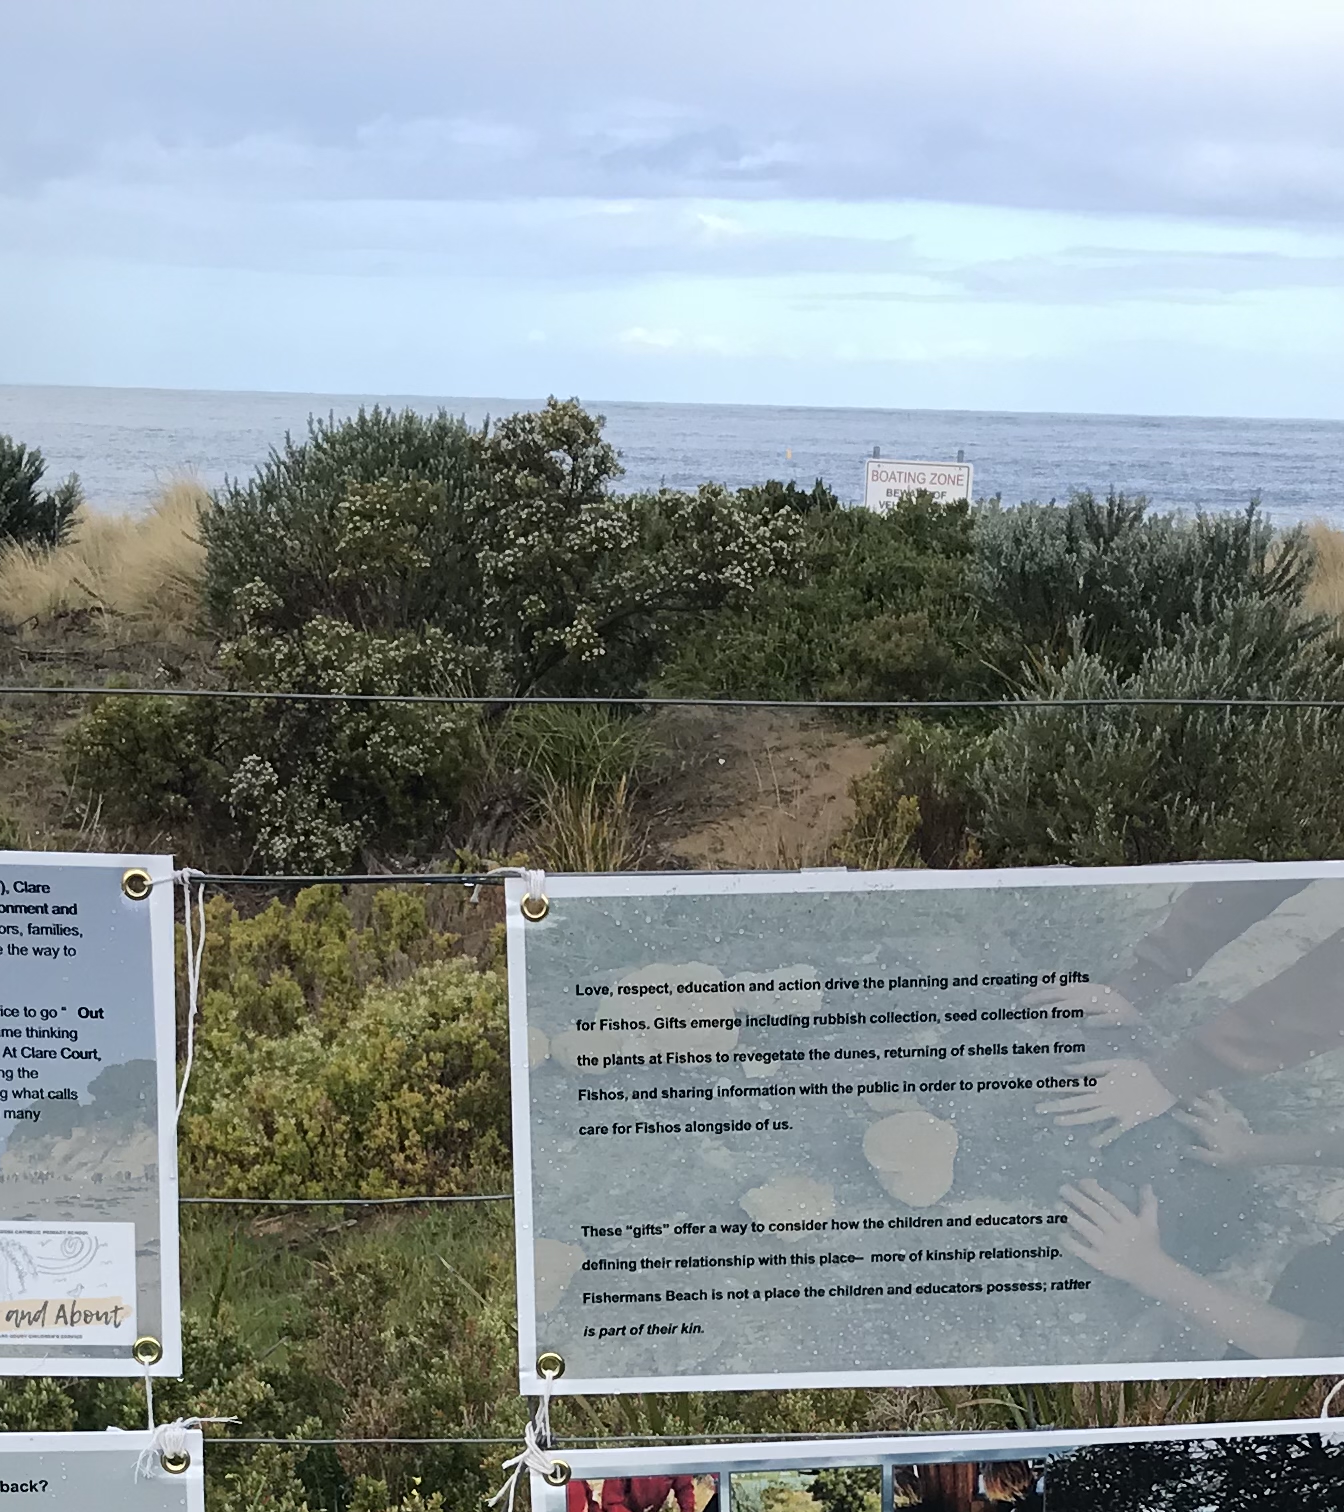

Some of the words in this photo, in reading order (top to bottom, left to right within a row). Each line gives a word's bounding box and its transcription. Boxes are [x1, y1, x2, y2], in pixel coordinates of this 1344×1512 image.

[871, 470, 926, 484] BOATING
[929, 473, 964, 486] ZONE
[6, 943, 28, 956] the
[31, 946, 60, 959] way
[63, 945, 76, 956] to
[575, 983, 613, 996] Love,
[617, 983, 672, 997] respect,
[676, 980, 745, 993] education
[748, 979, 774, 991] and
[777, 979, 820, 991] action
[824, 977, 859, 990] drive
[862, 976, 884, 989] the
[888, 975, 948, 990] planning
[952, 974, 978, 986] and
[981, 973, 1037, 987] creating
[1041, 971, 1056, 984] of
[1059, 970, 1089, 986] gifts
[17, 1067, 38, 1079] the
[578, 1089, 628, 1101] Fishos,
[631, 1087, 657, 1100] and
[661, 1086, 713, 1100] sharing
[717, 1084, 795, 1097] information
[798, 1083, 827, 1095] with
[831, 1082, 853, 1094] the
[857, 1080, 899, 1096] public
[902, 1081, 915, 1091] in
[919, 1079, 956, 1092] order
[959, 1080, 973, 1090] to
[976, 1077, 1032, 1093] provoke
[1036, 1077, 1079, 1088] others
[1083, 1076, 1097, 1086] to
[6, 1301, 48, 1328] and
[54, 1300, 125, 1328] About
[583, 1325, 595, 1336] is
[598, 1325, 626, 1339] part
[629, 1323, 645, 1335] of
[646, 1323, 678, 1335] their
[680, 1323, 704, 1333] kin.
[0, 1480, 48, 1493] back?
